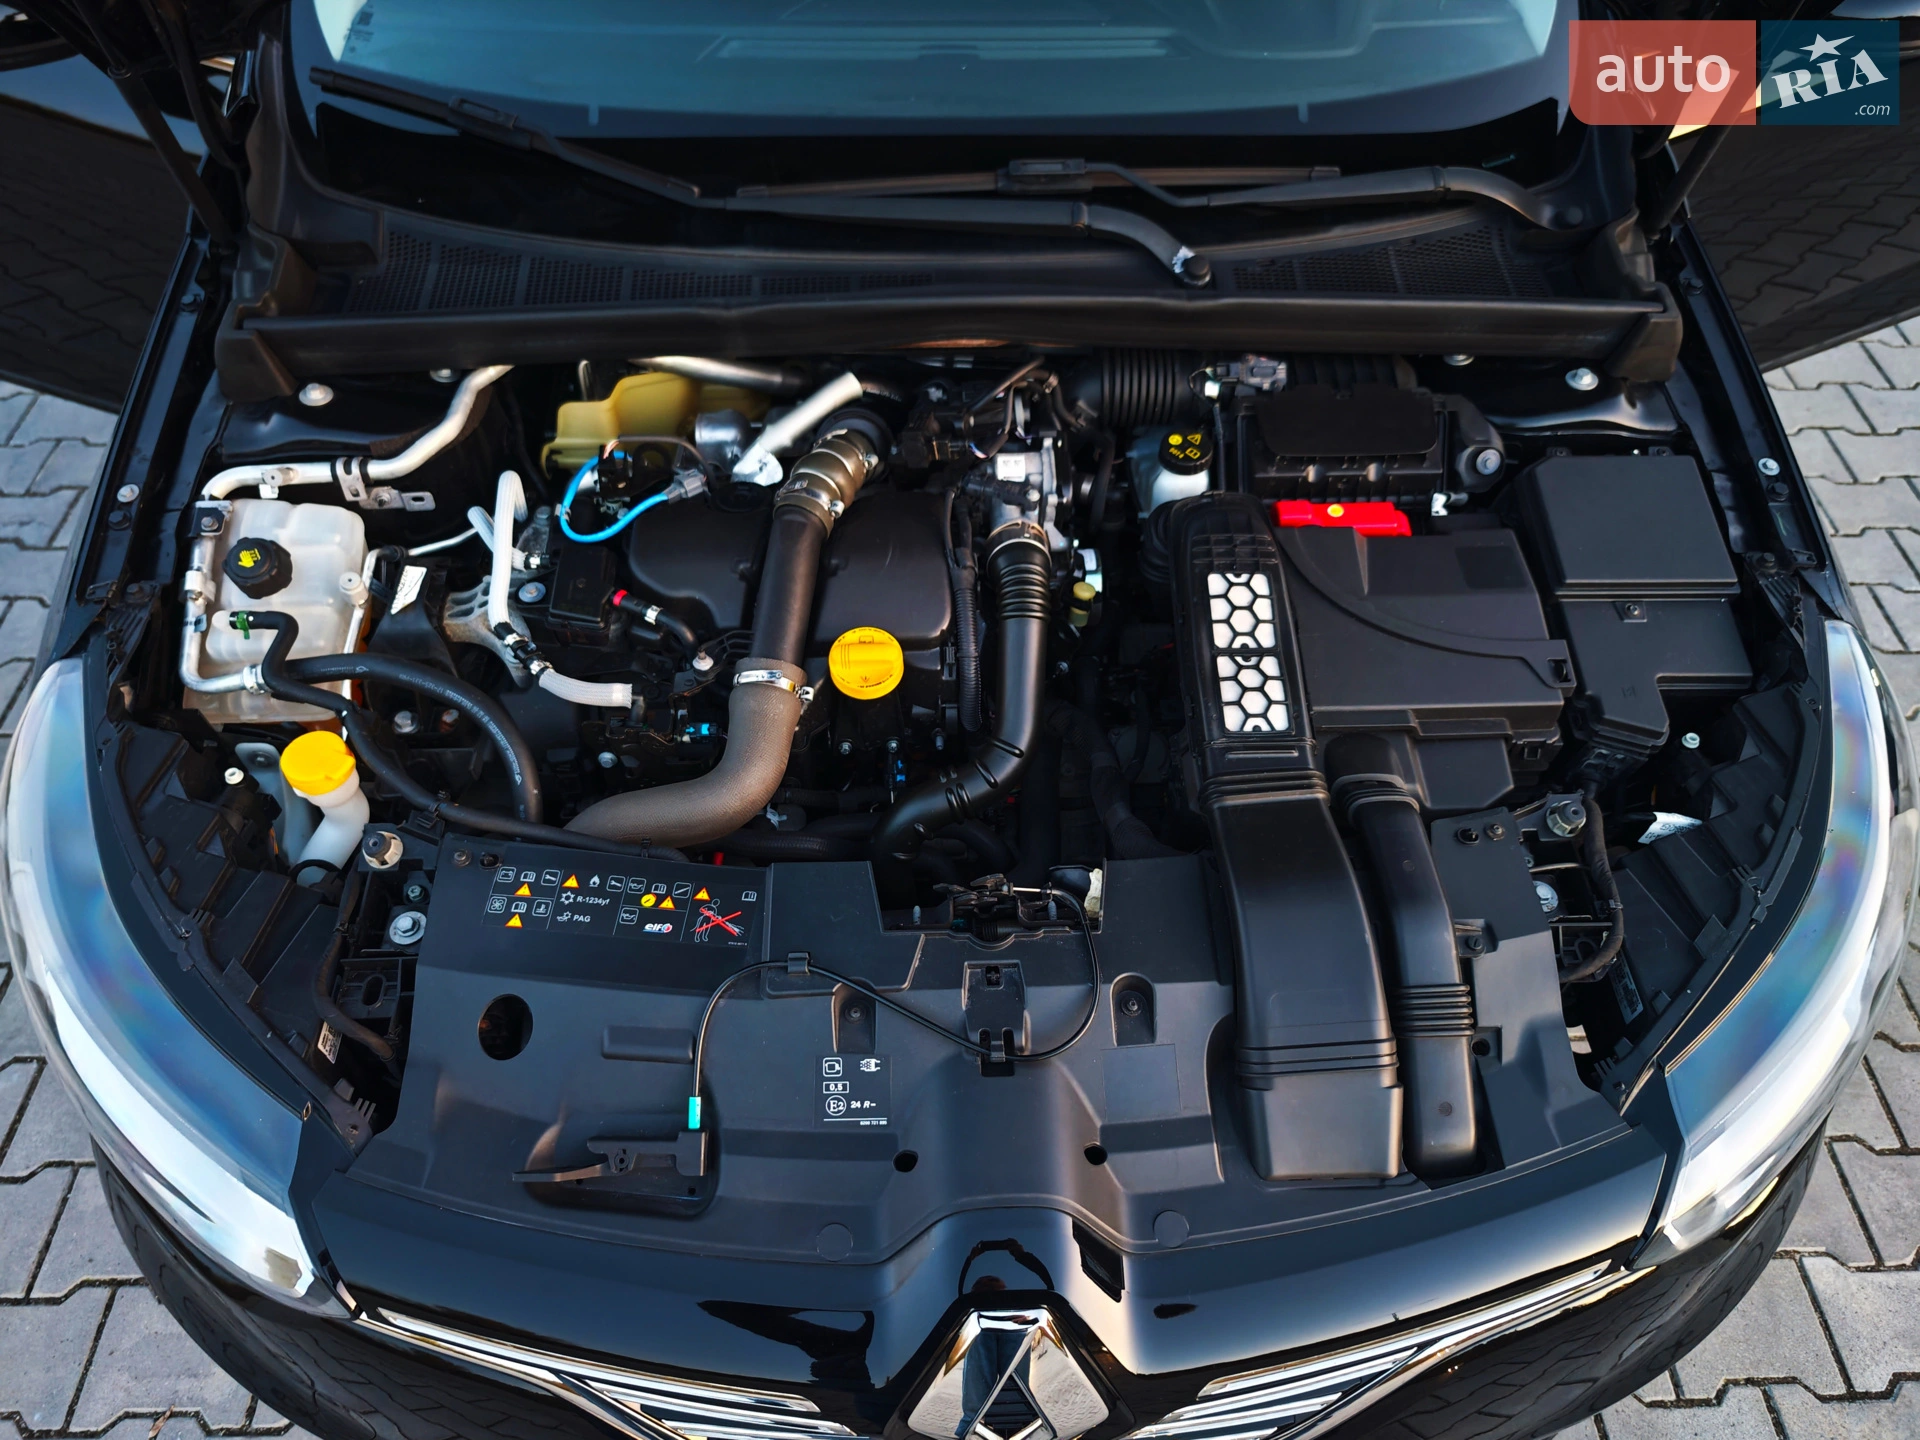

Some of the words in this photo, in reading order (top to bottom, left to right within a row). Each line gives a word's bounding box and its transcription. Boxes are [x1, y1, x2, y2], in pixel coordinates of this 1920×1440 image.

[576, 895, 610, 906] R-1234yf
[573, 914, 591, 923] PAG
[829, 1083, 843, 1091] 0,5
[829, 1100, 844, 1112] E2
